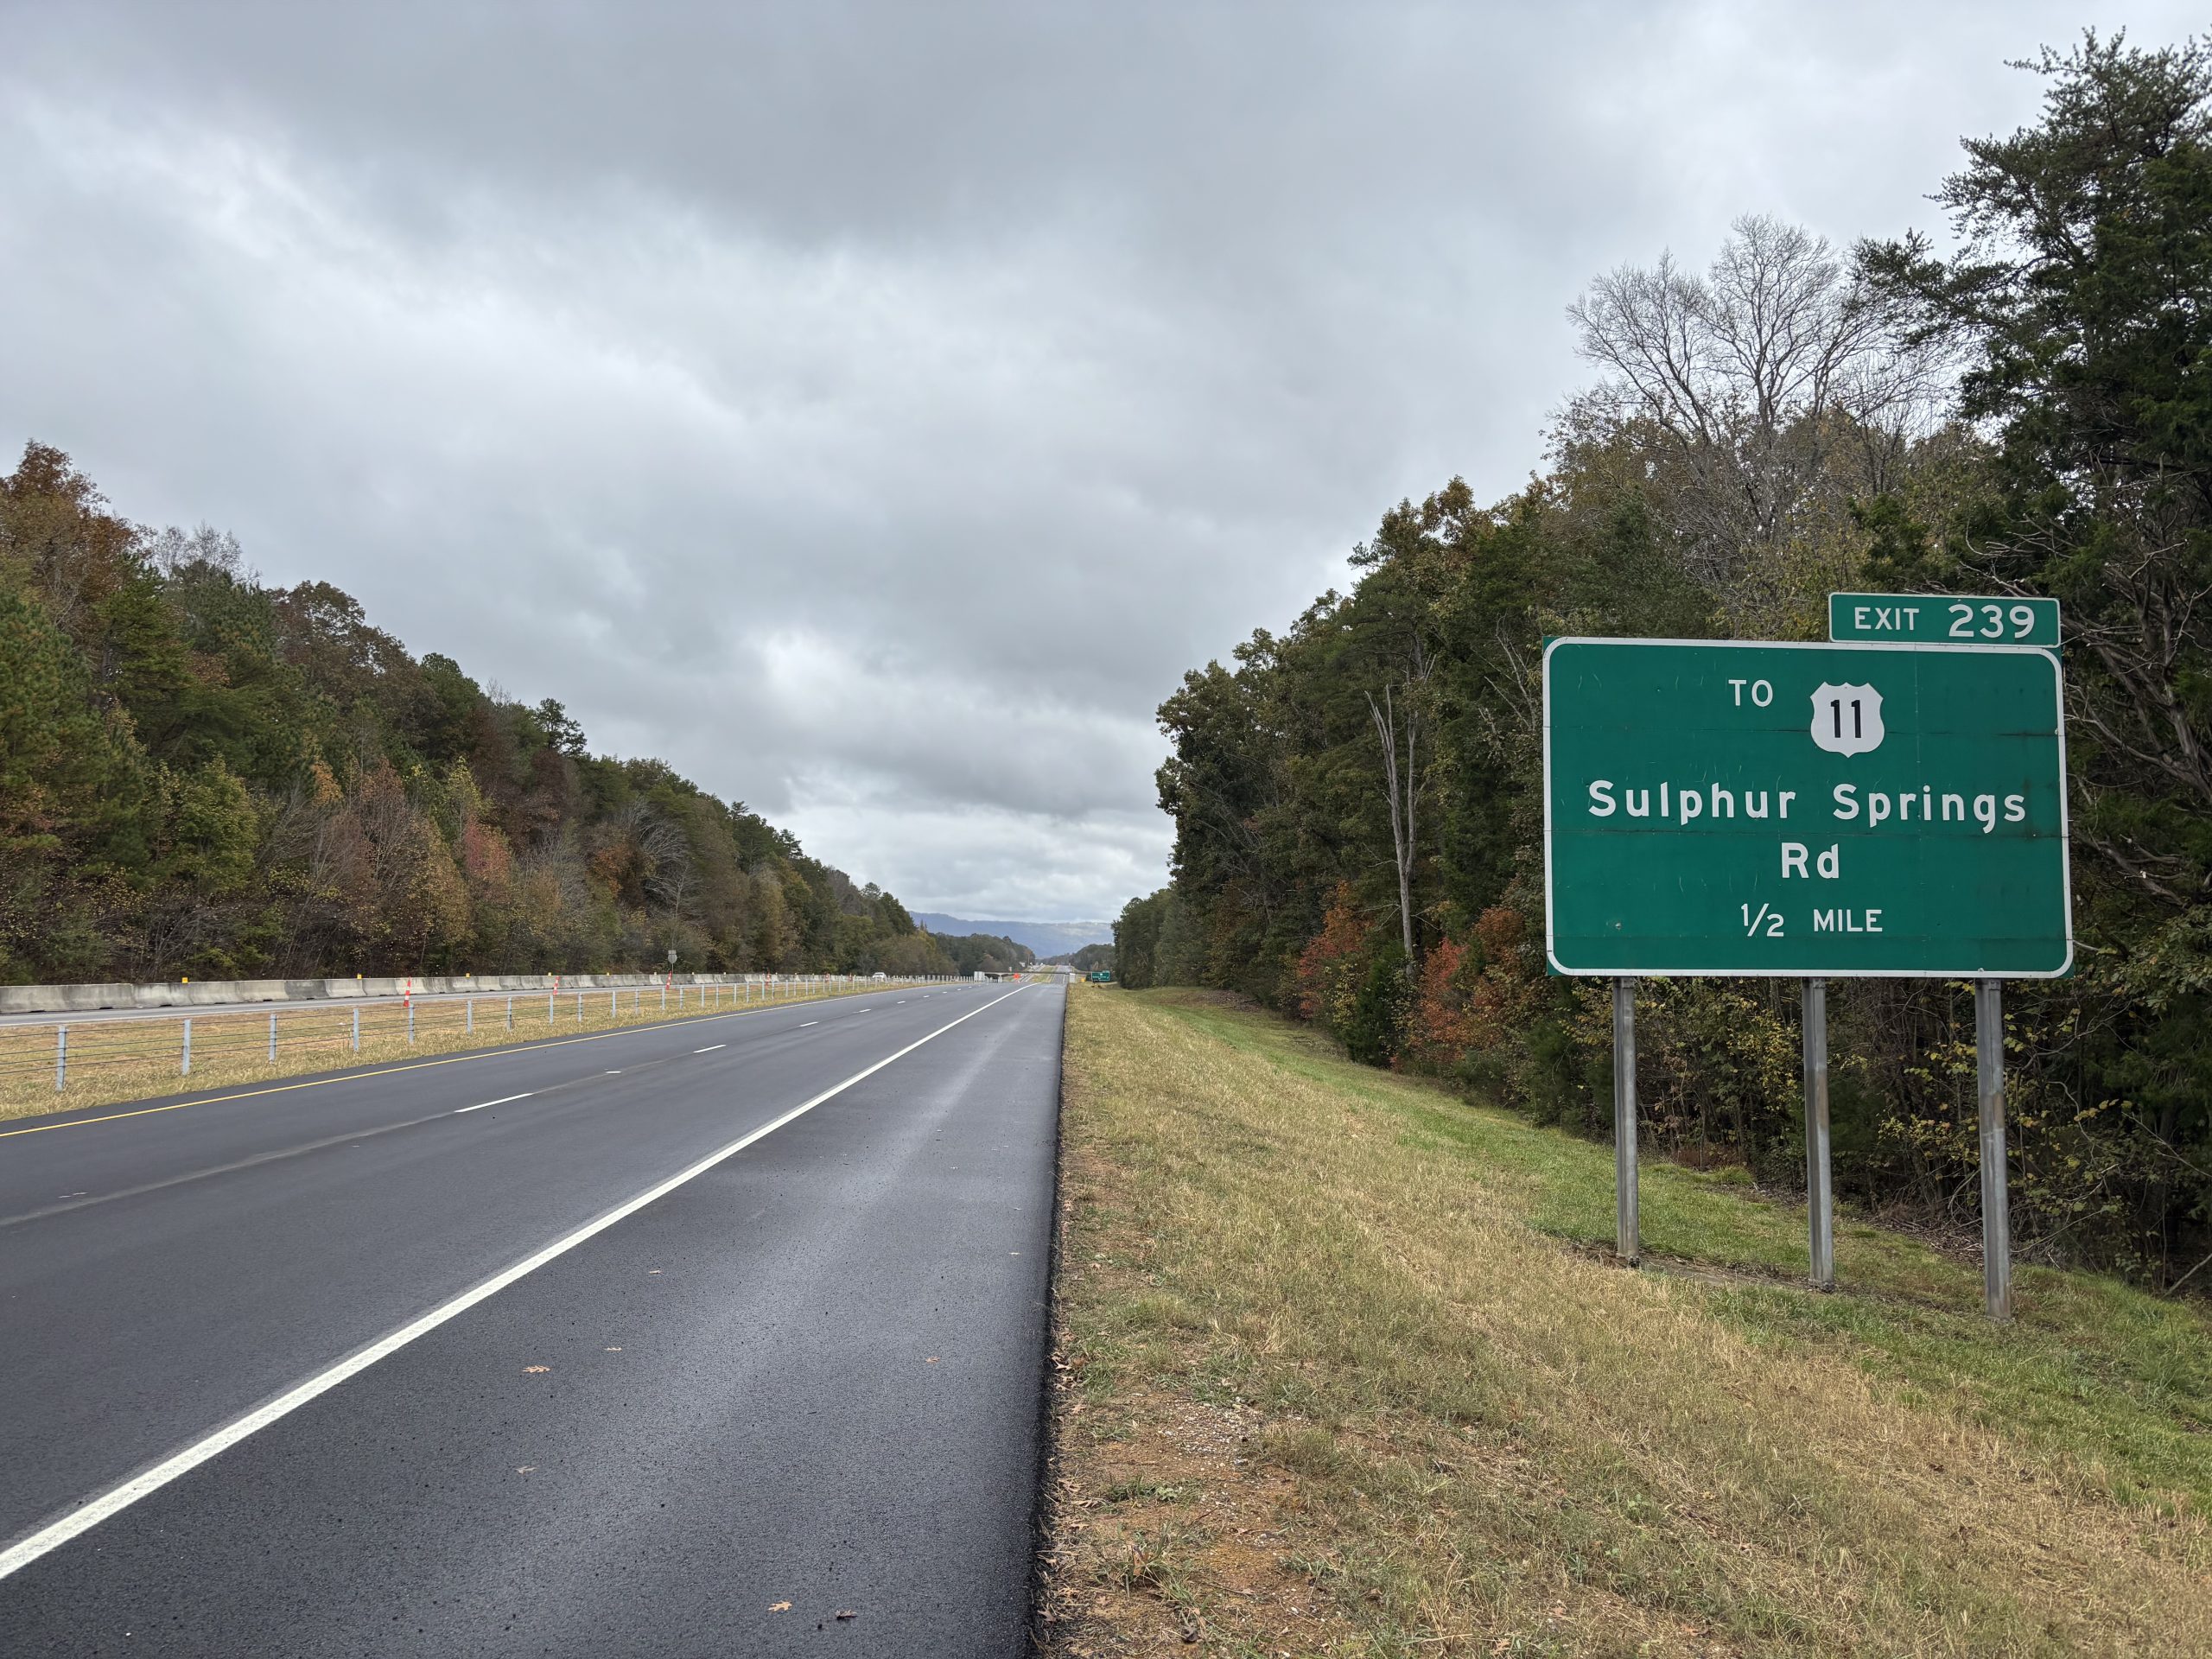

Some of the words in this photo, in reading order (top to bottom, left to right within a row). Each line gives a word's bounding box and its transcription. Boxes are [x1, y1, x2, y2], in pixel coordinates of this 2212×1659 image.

[1854, 607, 1920, 631] EXIT
[1948, 603, 2036, 639] 239
[1728, 679, 1773, 708] TO
[1830, 699, 1862, 739] 11
[1588, 779, 1796, 826] Sulphur
[1833, 783, 2026, 834] Springs
[1781, 842, 1840, 879] Rd
[1813, 909, 1883, 932] MILE
